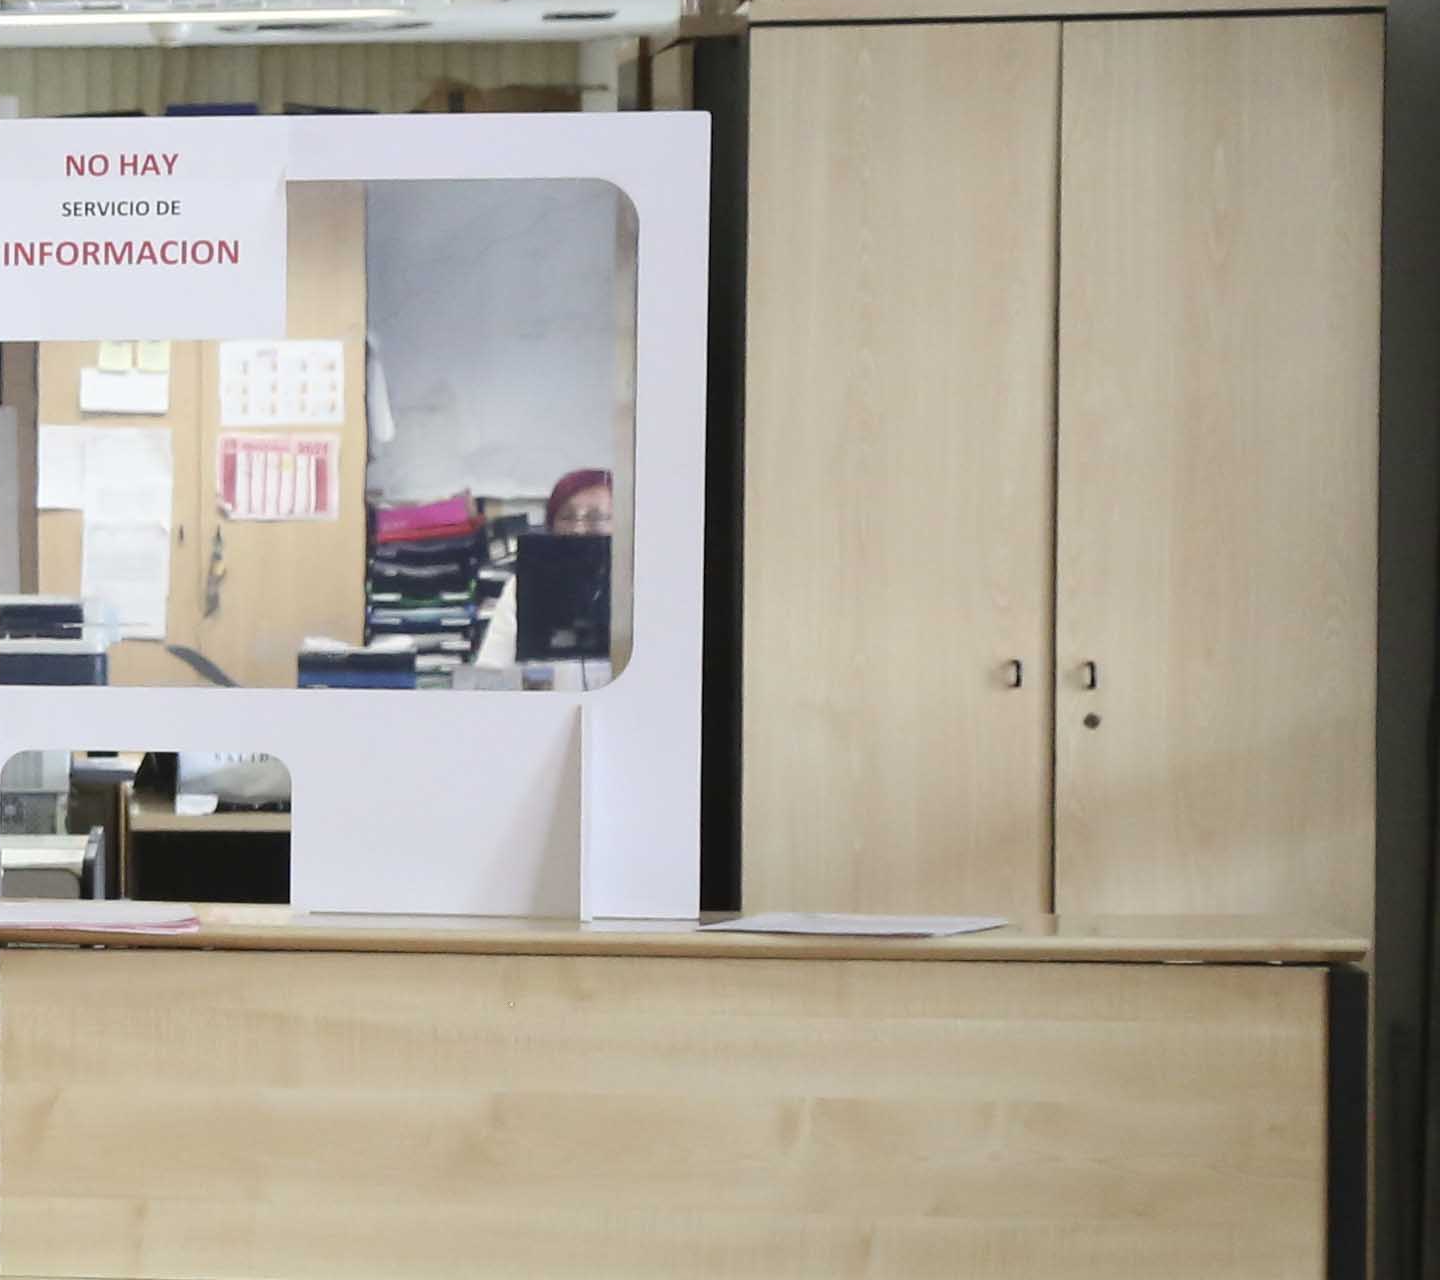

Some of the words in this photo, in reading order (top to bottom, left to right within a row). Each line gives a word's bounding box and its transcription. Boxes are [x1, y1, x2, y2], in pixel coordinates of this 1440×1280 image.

[65, 153, 109, 177] NO
[119, 153, 179, 176] HAY
[61, 200, 150, 217] SERVICIO
[156, 199, 181, 216] DE
[3, 239, 240, 267] INFORMACION
